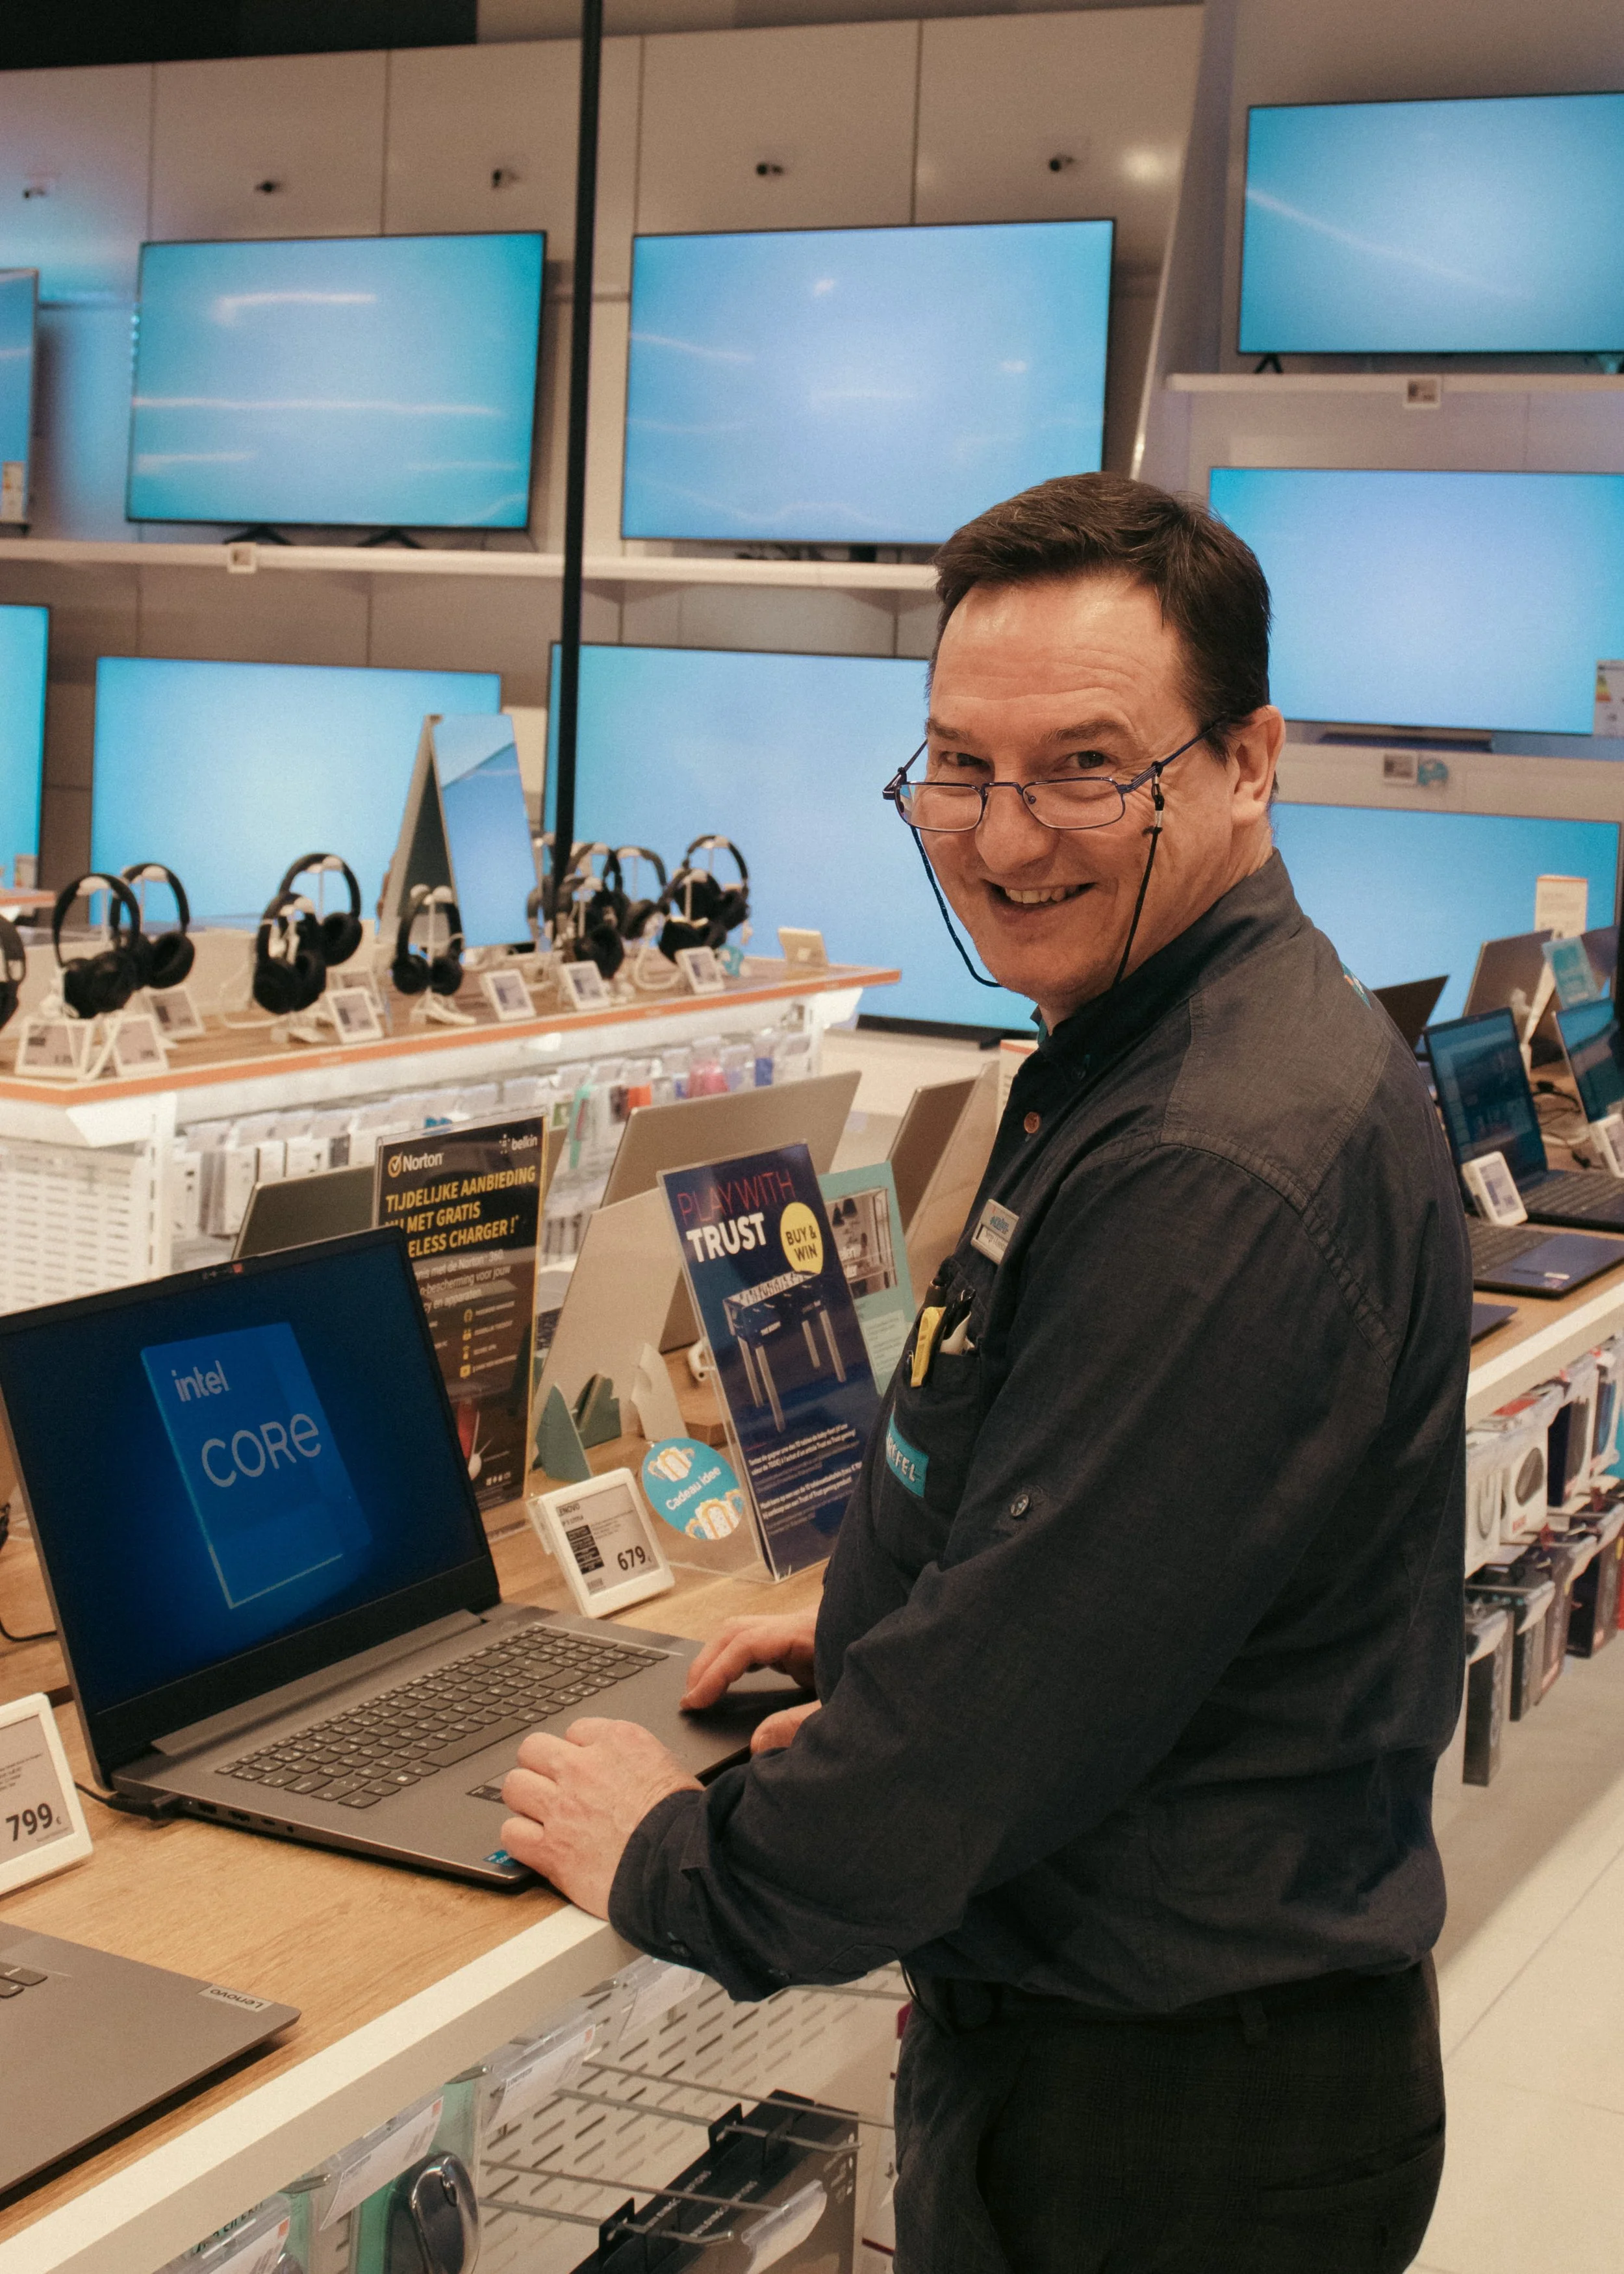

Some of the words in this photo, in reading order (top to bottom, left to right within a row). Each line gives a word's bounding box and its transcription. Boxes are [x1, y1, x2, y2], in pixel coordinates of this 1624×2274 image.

[511, 1134, 538, 1151] belkin
[403, 1153, 443, 1172] Norton
[386, 1181, 458, 1213] TIJDELIJKE
[461, 1166, 536, 1197] AANBIEDING
[678, 1182, 734, 1227] PLAY
[734, 1170, 797, 1210] WITH
[407, 1212, 435, 1234] MET
[437, 1201, 481, 1227] GRATIS
[785, 1227, 810, 1246] BUY
[810, 1225, 817, 1240] &
[408, 1233, 447, 1258] ELESS
[450, 1219, 508, 1248] CHARGER
[685, 1212, 767, 1263] TRUST
[794, 1244, 818, 1262] WIN
[171, 1360, 229, 1402] intel
[666, 1481, 702, 1511] Cadeau
[698, 1466, 721, 1485] idee
[617, 1546, 646, 1571] 679
[6, 1803, 53, 1842] 799
[210, 1989, 264, 2009] Lenovo
